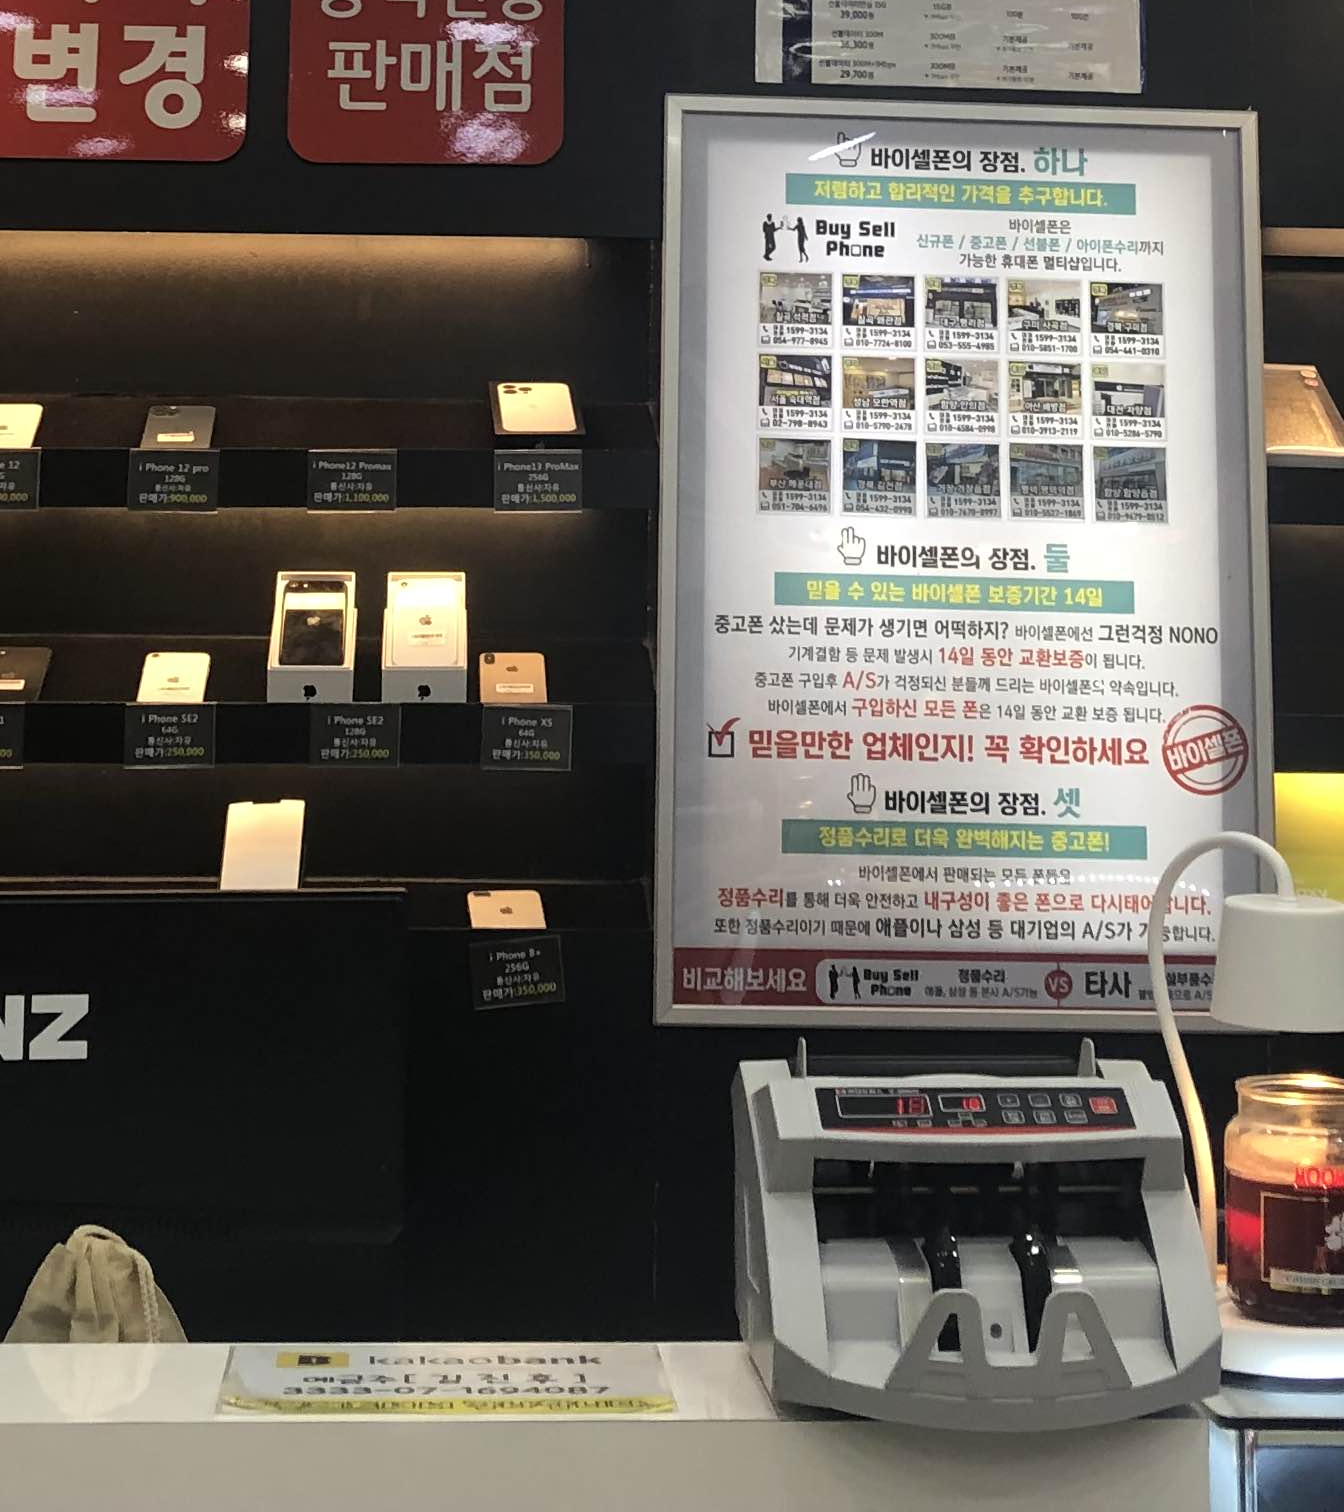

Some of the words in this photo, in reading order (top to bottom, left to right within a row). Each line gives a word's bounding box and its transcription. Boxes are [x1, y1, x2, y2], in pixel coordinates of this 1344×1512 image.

[12, 23, 208, 128] 변경
[326, 35, 538, 114] 판매점
[871, 149, 971, 171] 바이셀폰의
[980, 151, 1025, 174] 장점.
[1034, 147, 1088, 176] 하나
[814, 178, 883, 200] 저렴하고
[889, 181, 955, 202] 합리적인
[962, 183, 1012, 205] 가격을
[1018, 186, 1108, 207] 추구합니다.
[816, 218, 851, 240] Buy
[859, 219, 896, 238] Sell
[1009, 219, 1071, 235] 바이셀폰은
[826, 240, 885, 258] Phone
[916, 234, 954, 249] 신규폰
[970, 235, 1008, 251] 중고폰
[1024, 236, 1061, 252] 선불폰
[1076, 239, 1165, 256] 아이폰수리까지
[959, 252, 997, 268] 가능한
[1001, 255, 1039, 271] 휴대폰
[1043, 256, 1122, 273] 멀티샵입니다.
[1035, 333, 1077, 343] 1599-3134
[145, 463, 176, 473] Phone
[877, 544, 980, 570] 바이셀폰의
[1043, 543, 1071, 574] 둘
[807, 580, 840, 601] 믿을
[847, 581, 864, 601] 수
[871, 582, 905, 602] 있는
[912, 583, 981, 604] 바이셀폰
[988, 585, 1058, 606] 보증기간
[1064, 587, 1104, 608] 14일
[714, 614, 764, 635] 중고폰
[769, 616, 818, 636] 샀는데
[824, 617, 874, 637] 문제가
[880, 619, 928, 639] 생기면
[1015, 625, 1093, 643] 바이셀폰에선
[1097, 624, 1163, 645] 그런걱정
[1169, 626, 1218, 645] NONO
[788, 646, 841, 663] 기계결함
[846, 647, 859, 663] 등
[863, 648, 889, 664] 문제
[894, 648, 933, 664] 발생시
[937, 647, 975, 666] 14일
[980, 648, 1013, 667] 동안
[1018, 648, 1093, 669] 교환보증이
[1102, 653, 1146, 670] 됩니다.
[754, 671, 794, 688] 중고폰
[798, 673, 838, 689] 구입후
[842, 671, 890, 690] A/S가
[895, 675, 946, 691] 걱정되신
[951, 676, 991, 692] 분들께
[994, 677, 1035, 694] 드리는
[1108, 680, 1179, 697] 약속입니다.
[767, 699, 847, 716] 바이셀폰에서
[851, 698, 918, 718] 구입하신
[923, 700, 956, 719] 모든
[961, 701, 992, 720] 폰은
[997, 704, 1025, 720] 14일
[1029, 705, 1057, 721] 동안
[1061, 705, 1087, 722] 교환
[1091, 706, 1117, 722] 보증
[1122, 706, 1167, 723] 됩니다.
[748, 730, 854, 760] 믿을만한
[862, 731, 974, 762] 업체인지!
[984, 735, 1010, 763] 꼭
[1019, 735, 1150, 766] 확인하세요
[1166, 729, 1245, 771] 바이셀폰
[885, 790, 990, 815] 바이셀폰의
[998, 792, 1046, 817] 장점.
[1053, 787, 1081, 818] 셋
[819, 825, 908, 848] 정품수리로
[914, 827, 950, 849] 더욱
[955, 828, 1045, 852] 완벽해지는
[858, 865, 939, 883] 바이셀폰에서
[943, 866, 997, 884] 판매되는
[718, 888, 798, 909] 정품수리를
[803, 891, 830, 908] 통해
[834, 892, 861, 909] 더욱
[865, 892, 918, 910] 안전하고
[924, 892, 990, 912] 내구성이
[996, 893, 1029, 912] 좋은
[1034, 893, 1085, 912] 폰으로
[1091, 894, 1212, 916] 다시태어니다.
[714, 918, 741, 936] 또한
[745, 919, 826, 937] 정품수리이기
[830, 921, 872, 937] 때문에
[876, 918, 942, 938] 애플이나
[947, 918, 981, 939] 삼성
[987, 920, 1003, 940] 등
[1009, 920, 1076, 941] 대기업의
[1081, 920, 1132, 942] A/S가
[496, 950, 526, 961] Phone
[682, 968, 808, 993] 비교해보세요
[863, 969, 888, 984] Buy
[893, 969, 919, 982] Sell
[957, 968, 1006, 985] 정품수리
[1047, 976, 1070, 993] VS
[1084, 970, 1132, 999] 타사
[368, 1354, 602, 1365] kakaobank
